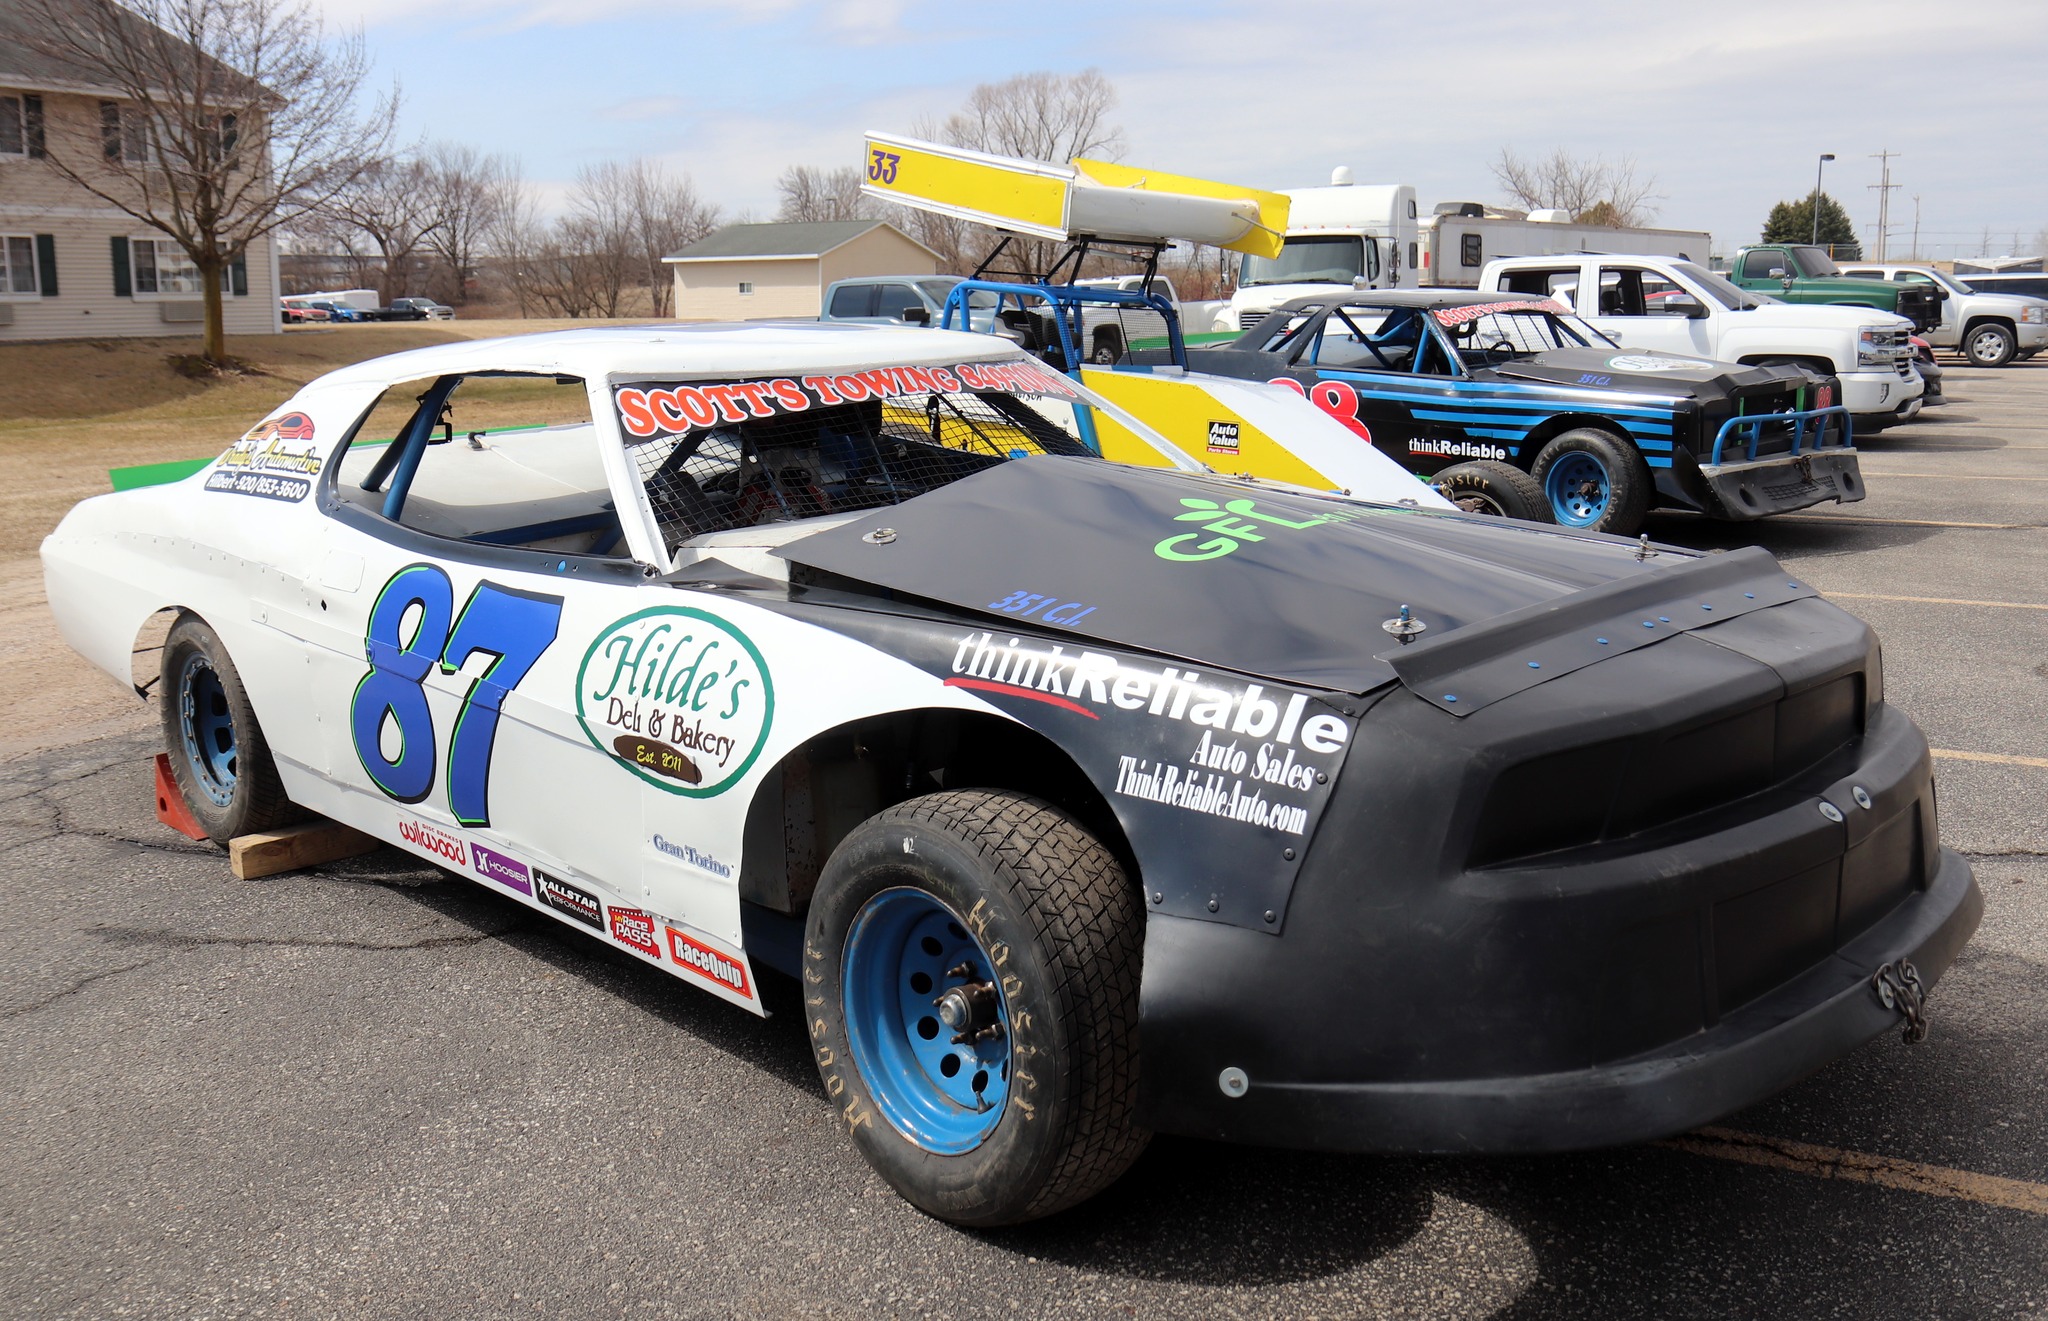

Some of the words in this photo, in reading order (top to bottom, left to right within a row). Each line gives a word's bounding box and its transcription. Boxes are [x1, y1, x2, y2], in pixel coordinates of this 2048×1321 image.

[869, 149, 901, 184] 33
[1577, 374, 1595, 385] 351
[616, 379, 811, 437] SCOTT'S
[801, 365, 962, 406] TOWING
[1209, 433, 1239, 447] Value
[1210, 423, 1238, 436] Auto
[250, 438, 322, 476] Automotive
[1408, 437, 1507, 461] thinkReliable
[206, 474, 237, 490] Hilbert
[236, 475, 308, 499] 920/853-3600
[1154, 500, 1328, 562] GFL
[987, 590, 1043, 617] 351
[1042, 595, 1097, 626] C.I.
[593, 624, 750, 720] Hilde's
[350, 562, 565, 828] 87
[951, 632, 1349, 754] thinkReliable
[606, 697, 641, 733] Deli
[649, 709, 666, 738] &
[671, 714, 735, 768] Bakery
[636, 745, 657, 764] Est.
[661, 752, 682, 772] 2011
[1189, 730, 1248, 775] Auto
[1250, 742, 1315, 792] Sales
[1114, 755, 1308, 836] ThinkReliableAuto.com
[399, 821, 466, 866] wilwood
[422, 824, 436, 833] DISC
[436, 830, 459, 843] BRAKES
[489, 861, 529, 885] HOOSIER
[653, 833, 685, 860] Gran
[684, 844, 730, 878] Torino
[548, 881, 598, 911] ALLSTAR
[549, 893, 601, 922] PERFORMANCE
[616, 922, 652, 947] PASS
[674, 934, 743, 988] RaceQuip
